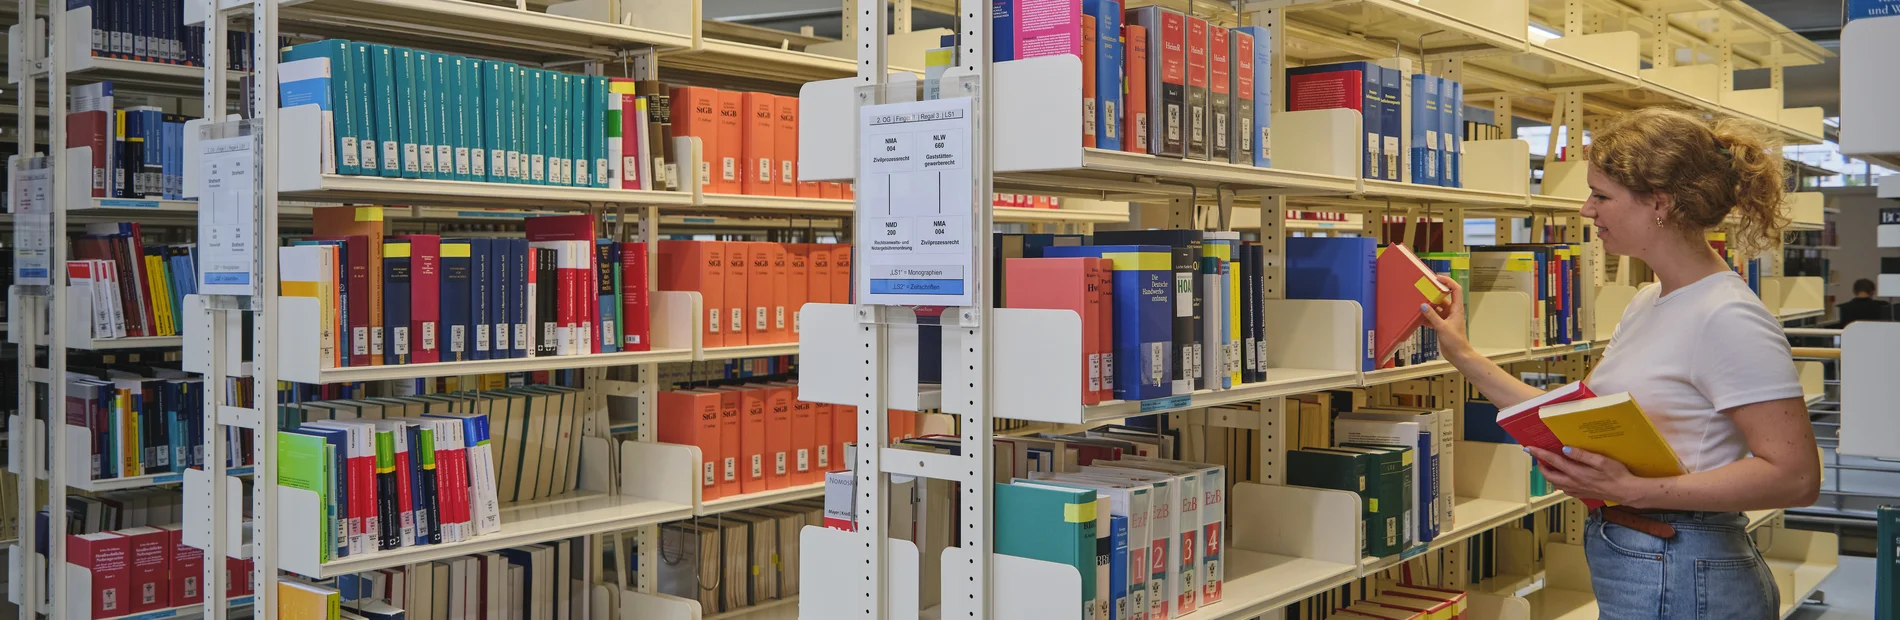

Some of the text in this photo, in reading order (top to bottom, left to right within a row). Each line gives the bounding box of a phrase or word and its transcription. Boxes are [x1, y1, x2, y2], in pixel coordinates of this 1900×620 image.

[1869, 6, 1888, 15] und
[1166, 42, 1180, 52] HeimR
[1191, 46, 1203, 55] HeimR
[1214, 54, 1226, 62] HeimR
[696, 106, 712, 114] StGB
[773, 405, 787, 414] StGB
[794, 402, 810, 411] StGB
[723, 410, 737, 418] StGB
[750, 407, 763, 416] StGB
[702, 412, 716, 421] StGB
[1205, 490, 1222, 505] EzB
[1182, 497, 1197, 512] EzB
[1153, 504, 1169, 520] EzB
[1208, 529, 1218, 549] 4
[1184, 539, 1192, 559] 3
[1154, 547, 1163, 569] 2
[1136, 557, 1142, 579] 1
